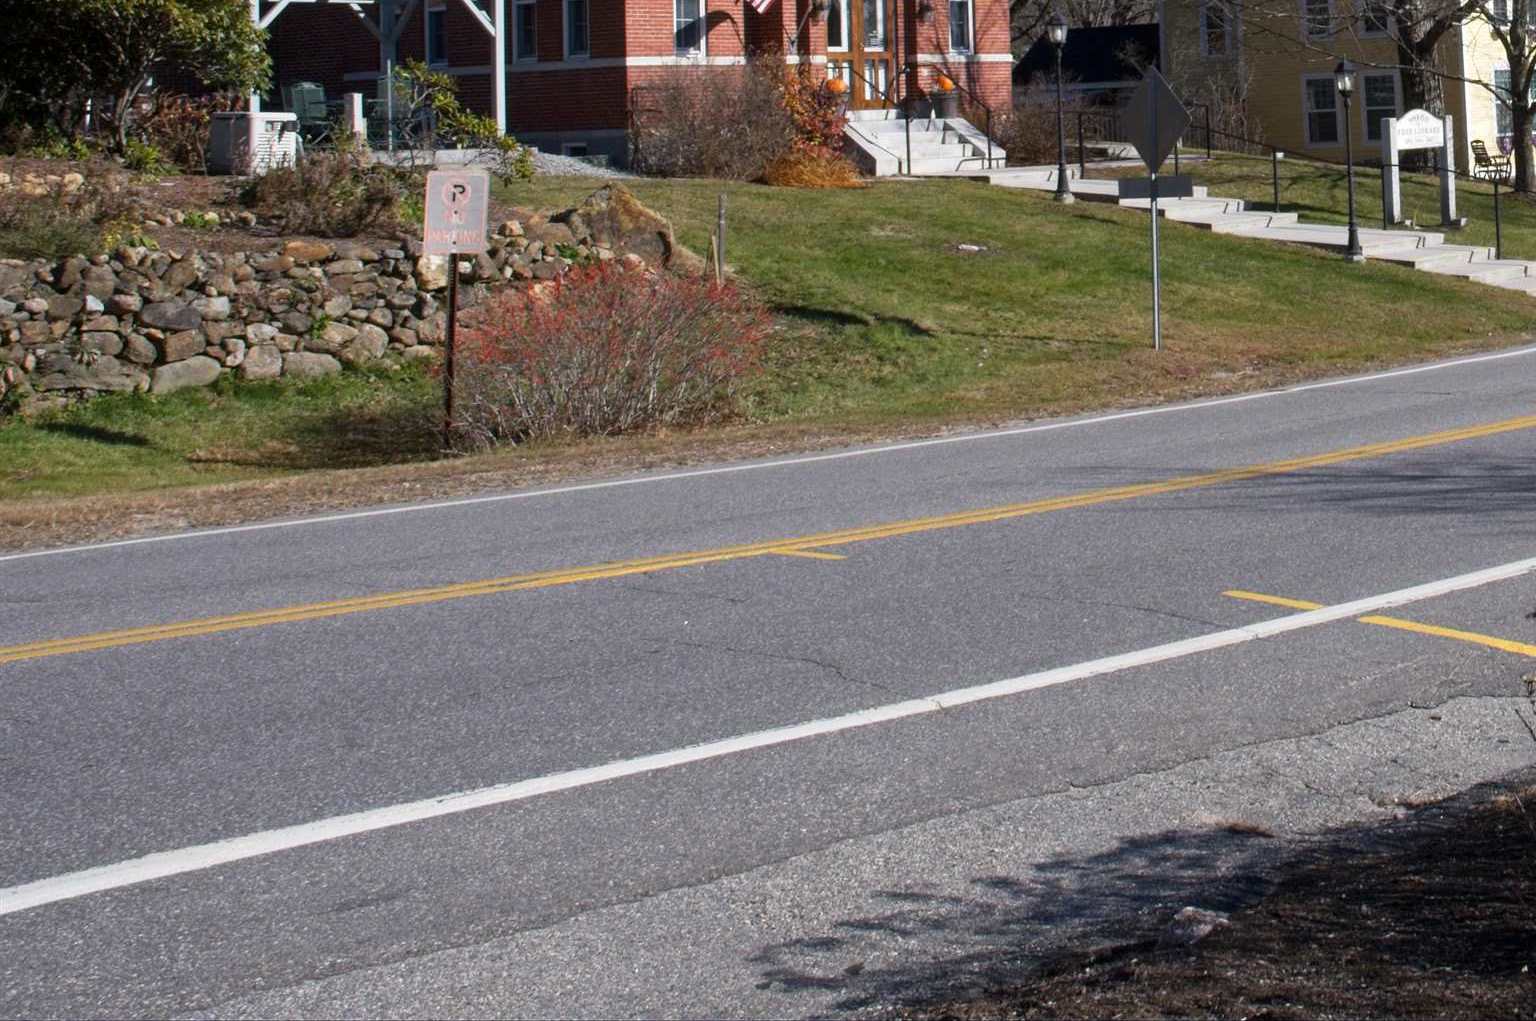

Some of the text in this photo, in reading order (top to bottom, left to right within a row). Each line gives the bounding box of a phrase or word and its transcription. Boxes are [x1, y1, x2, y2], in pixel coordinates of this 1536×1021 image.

[452, 184, 466, 202] P
[444, 211, 466, 224] NO
[430, 229, 481, 244] PARKING
